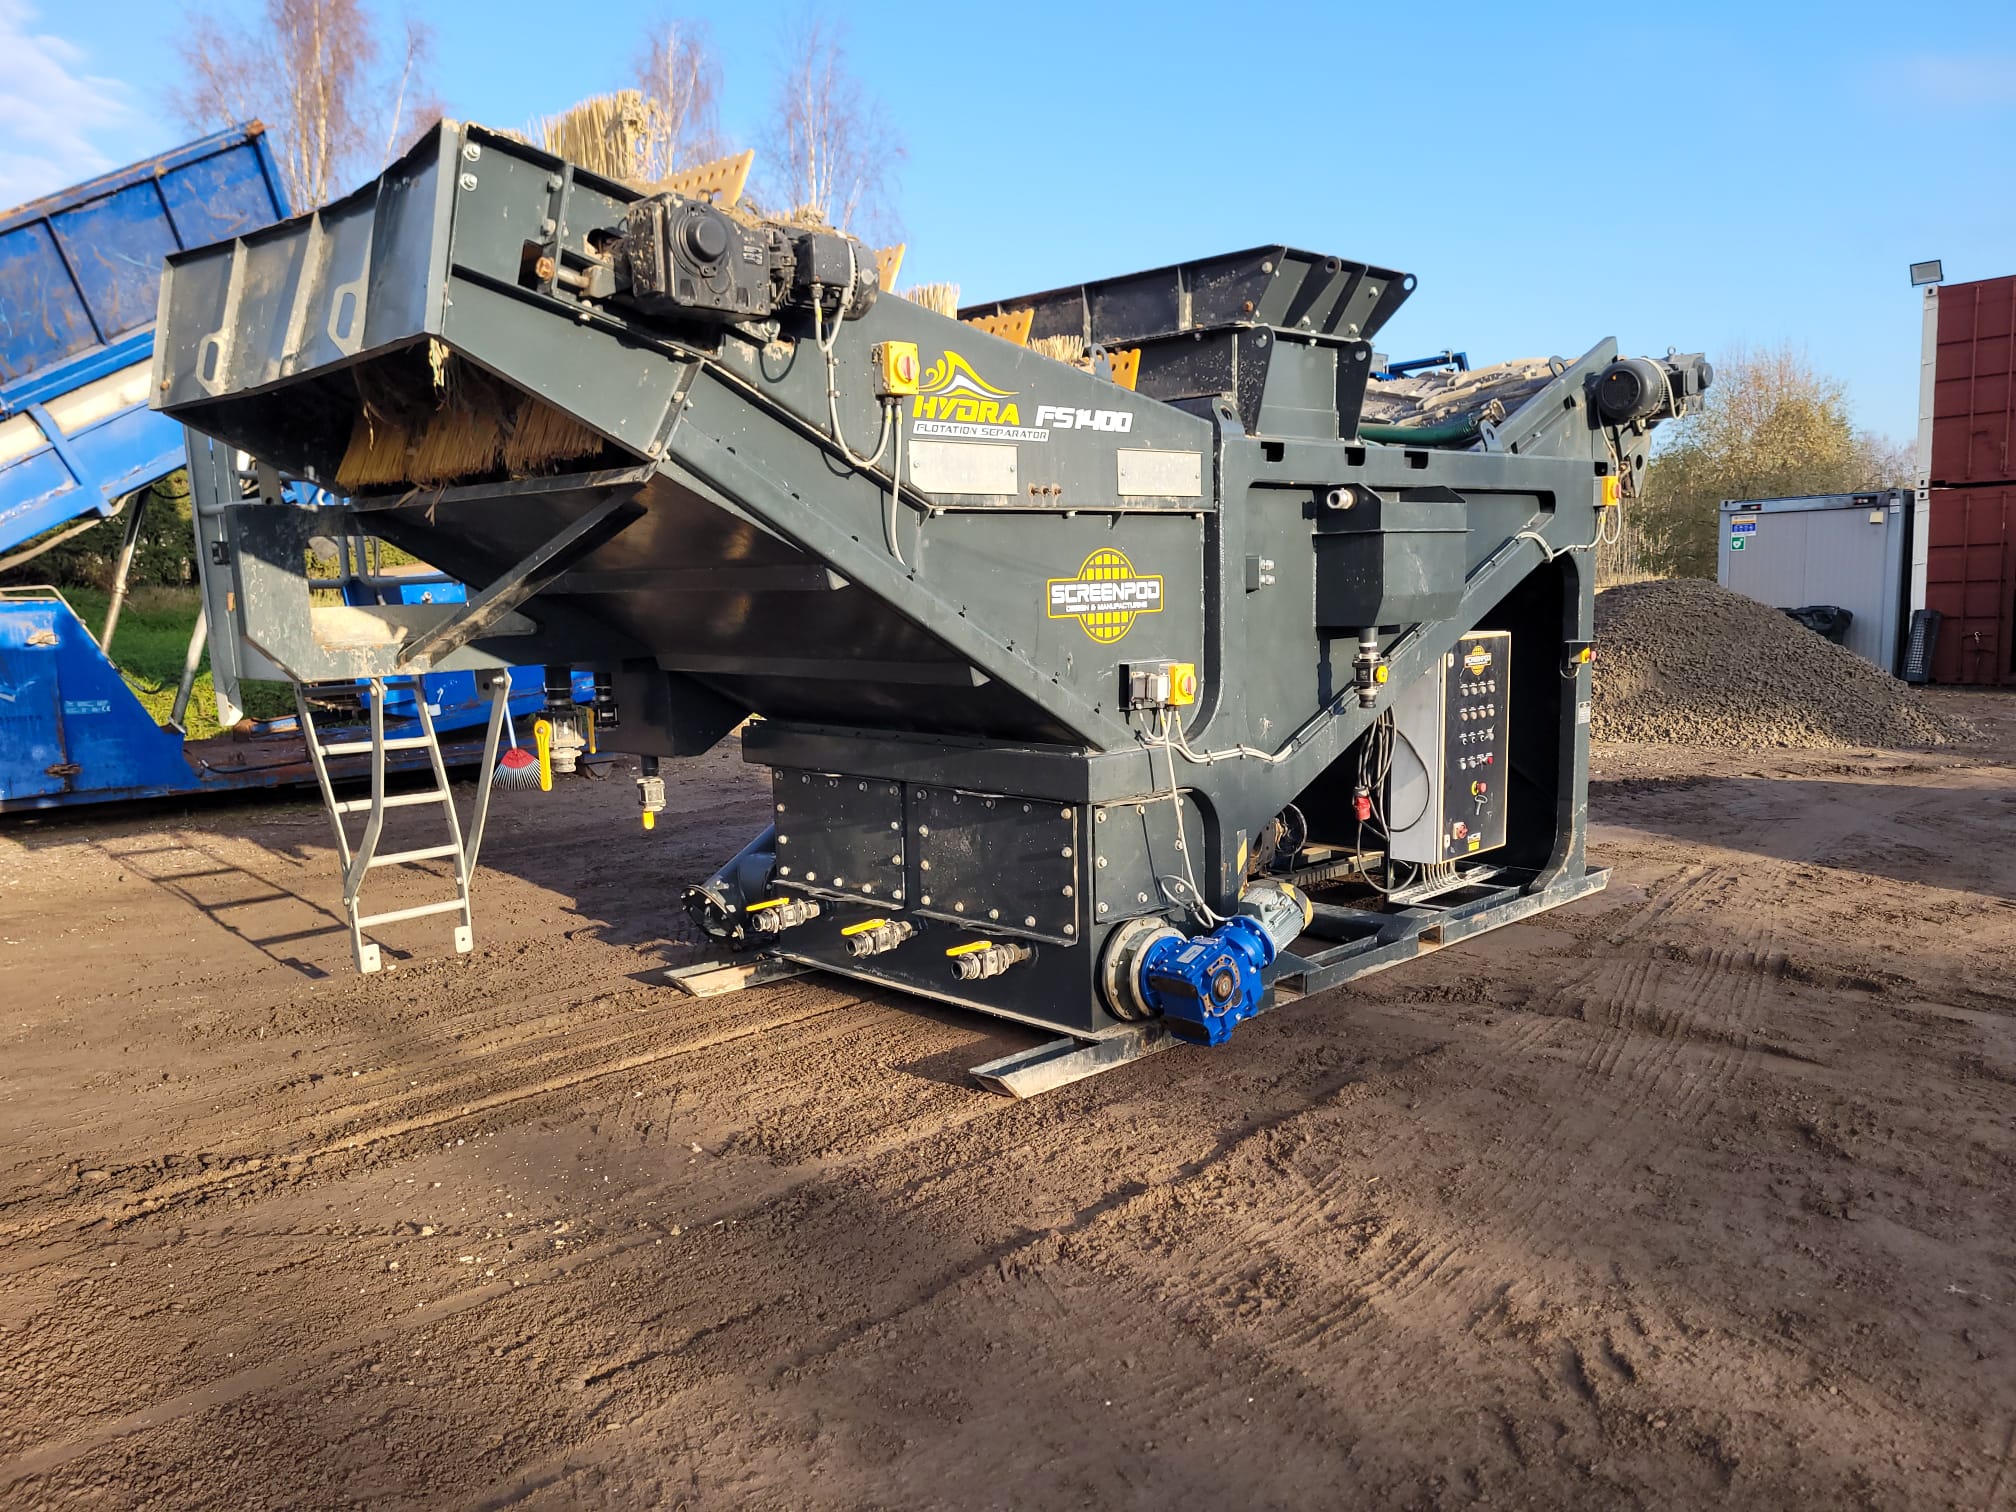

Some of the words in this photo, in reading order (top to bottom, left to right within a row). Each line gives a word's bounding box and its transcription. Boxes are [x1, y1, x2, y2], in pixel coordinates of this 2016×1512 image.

[912, 394, 1020, 426] HYDRA
[1035, 405, 1133, 433] FS1400
[916, 423, 978, 435] FLOTATION
[981, 427, 1048, 440] SEPARATOR
[1051, 581, 1160, 604] SCREENPOD
